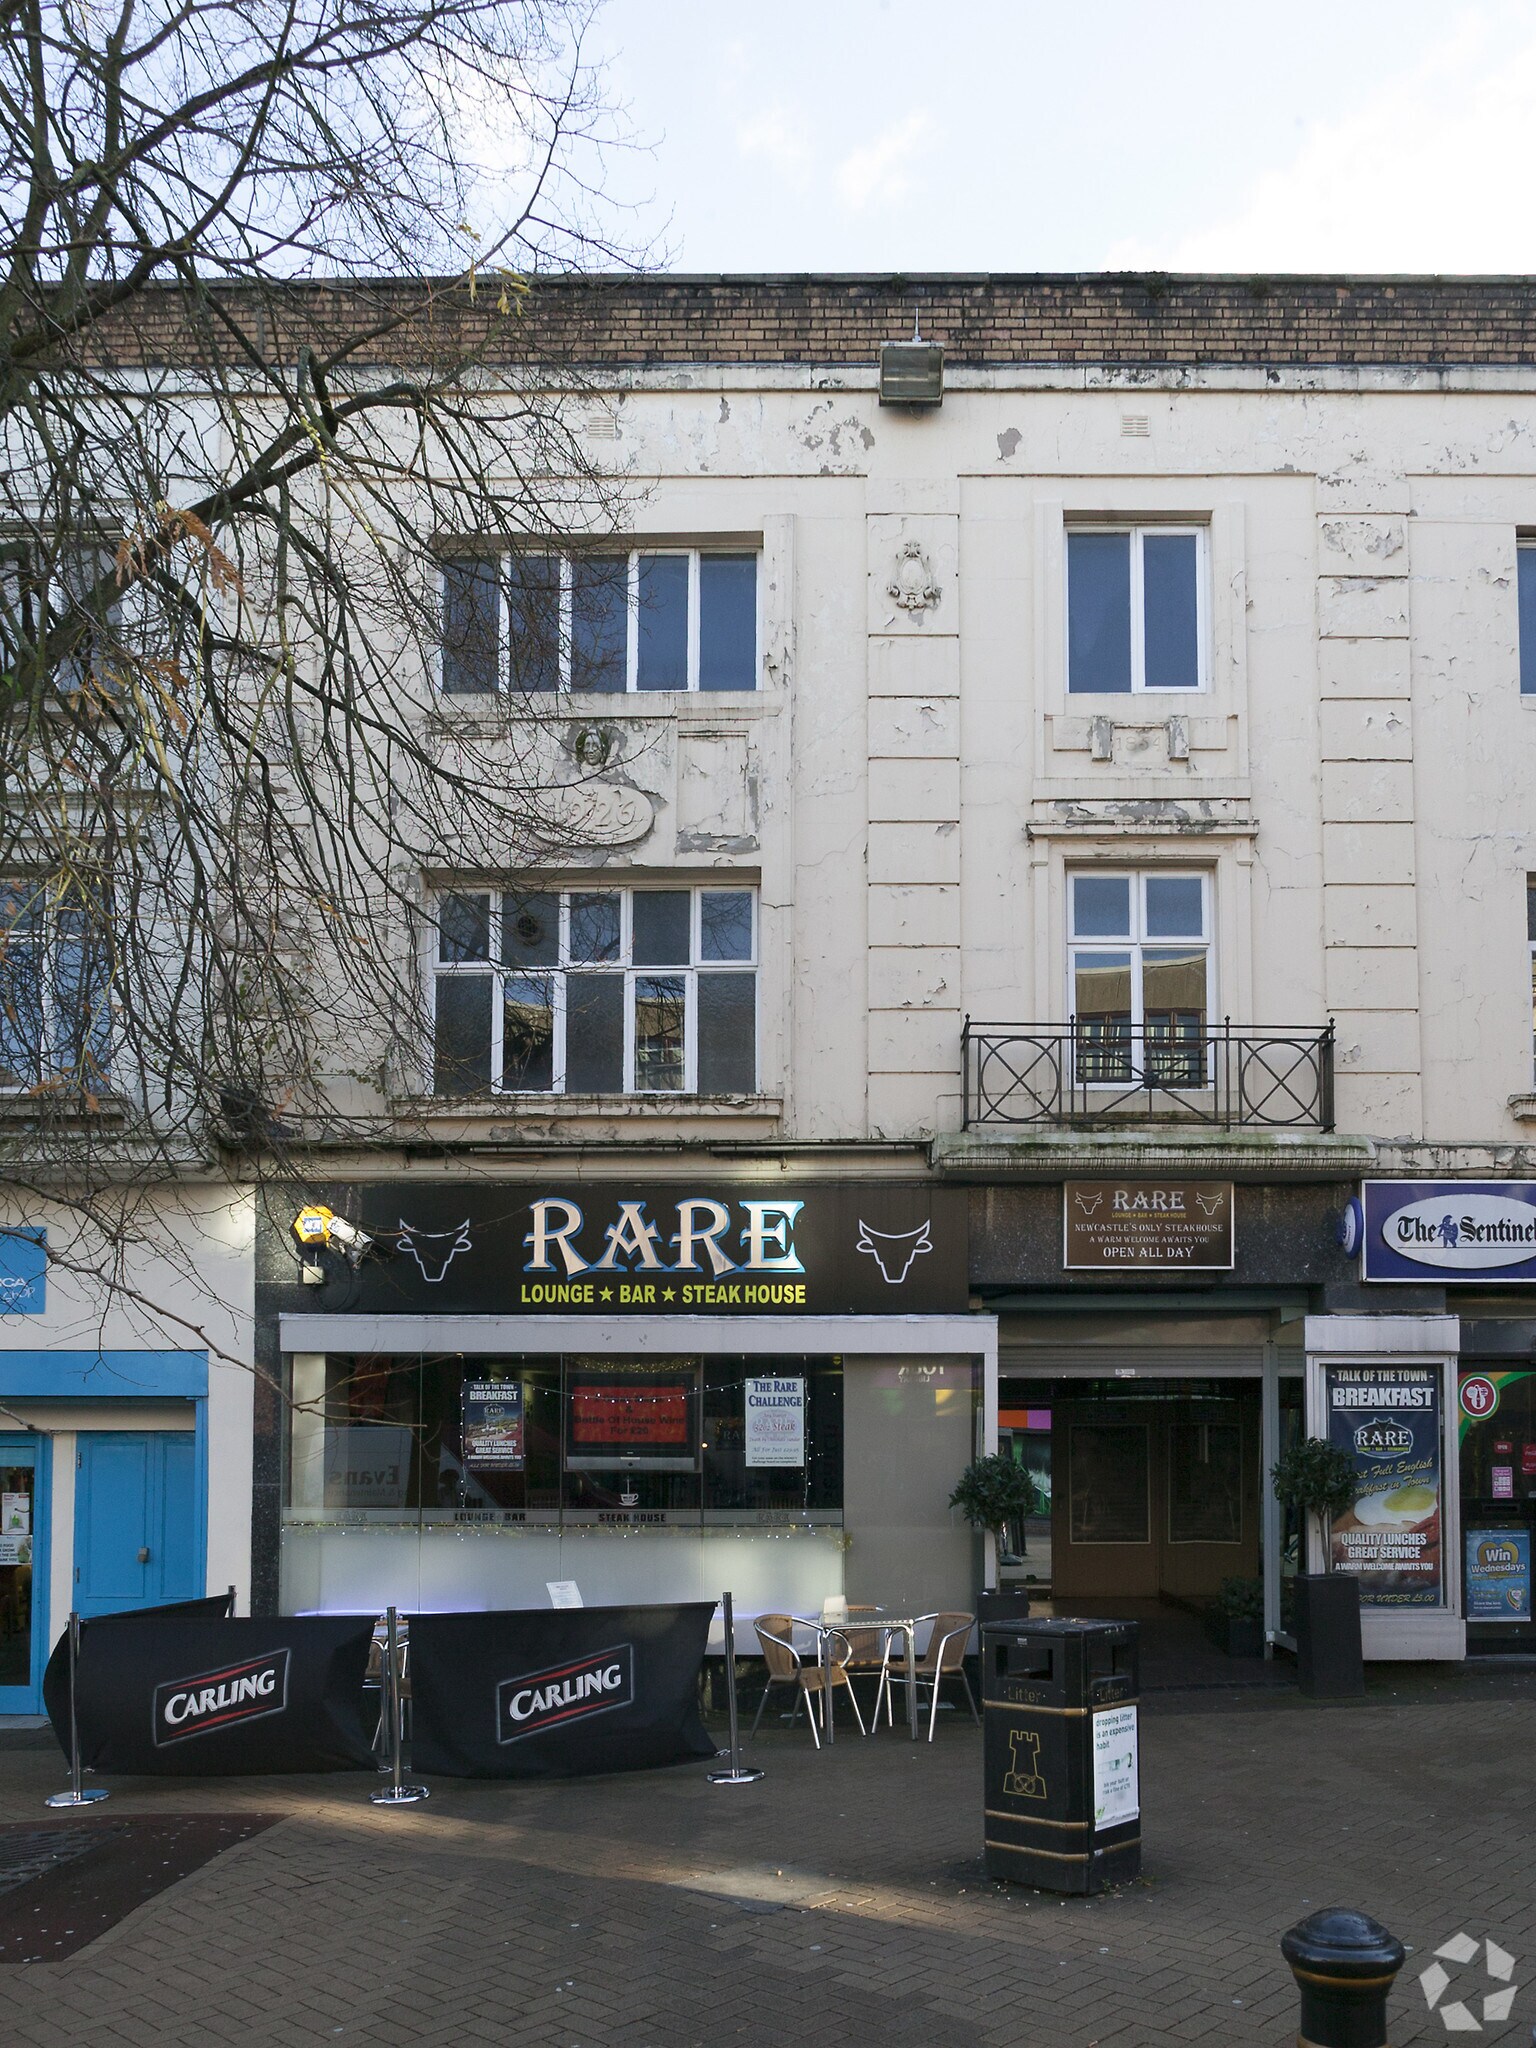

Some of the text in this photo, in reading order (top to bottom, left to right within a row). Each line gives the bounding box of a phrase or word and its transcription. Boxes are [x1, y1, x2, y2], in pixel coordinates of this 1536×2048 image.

[1112, 1190, 1186, 1210] RARE
[1075, 1223, 1223, 1232] NEWCASTLE'S ONLY STEAKHOUSE
[1397, 1216, 1437, 1242] The
[522, 1197, 806, 1281] RARE
[1103, 1245, 1194, 1258] OPEN ALL DAY
[521, 1284, 806, 1304] LOUNGE BAR STEAK HOUSE
[1337, 1370, 1428, 1382] TALK OF THE TOWN
[469, 1391, 518, 1400] BREAKFAST
[1332, 1387, 1434, 1406] BREAKFAST
[772, 1423, 796, 1432] Steak
[1357, 1431, 1409, 1446] RARE
[1371, 1465, 1393, 1478] Full
[1397, 1457, 1433, 1474] English
[1403, 1475, 1430, 1487] Town
[454, 1513, 494, 1521] LOUNGE
[504, 1513, 526, 1521] BAR
[599, 1514, 629, 1522] STEAK
[633, 1514, 666, 1522] HOUSE
[1341, 1533, 1427, 1546] QUALITY LUNCHES
[1348, 1547, 1421, 1559] GREAT SERVICE
[1485, 1549, 1511, 1561] Win
[1471, 1563, 1526, 1573] Wednesdays
[1376, 1594, 1411, 1603] UNDER
[164, 1669, 275, 1725] CARLING
[509, 1664, 622, 1721] CARLING
[1008, 1686, 1041, 1702] Litter
[1100, 1687, 1124, 1701] Litter
[1096, 1713, 1133, 1727] dropping litter
[1096, 1731, 1101, 1739] is
[1109, 1723, 1135, 1736] expensive
[1096, 1740, 1110, 1751] habit
